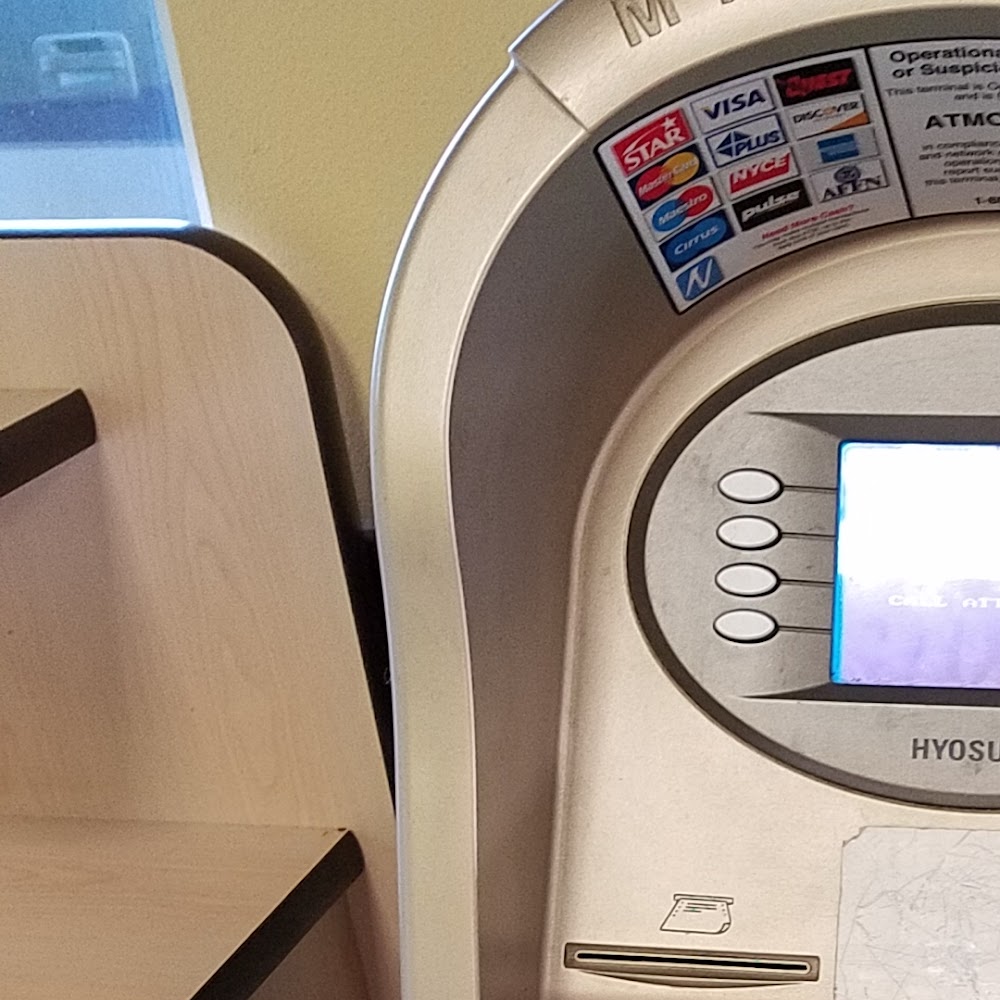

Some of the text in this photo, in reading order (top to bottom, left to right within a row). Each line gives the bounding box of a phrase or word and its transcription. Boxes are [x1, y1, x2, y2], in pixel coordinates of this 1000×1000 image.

[892, 68, 914, 78] or
[704, 89, 766, 120] VISA
[793, 102, 858, 124] DISCOVER
[624, 127, 686, 171] STAR
[736, 130, 781, 156] PLUS
[638, 156, 699, 199] MasterCard
[732, 153, 790, 185] NYCE
[823, 175, 881, 200] AFFN
[658, 192, 708, 226] Maestro
